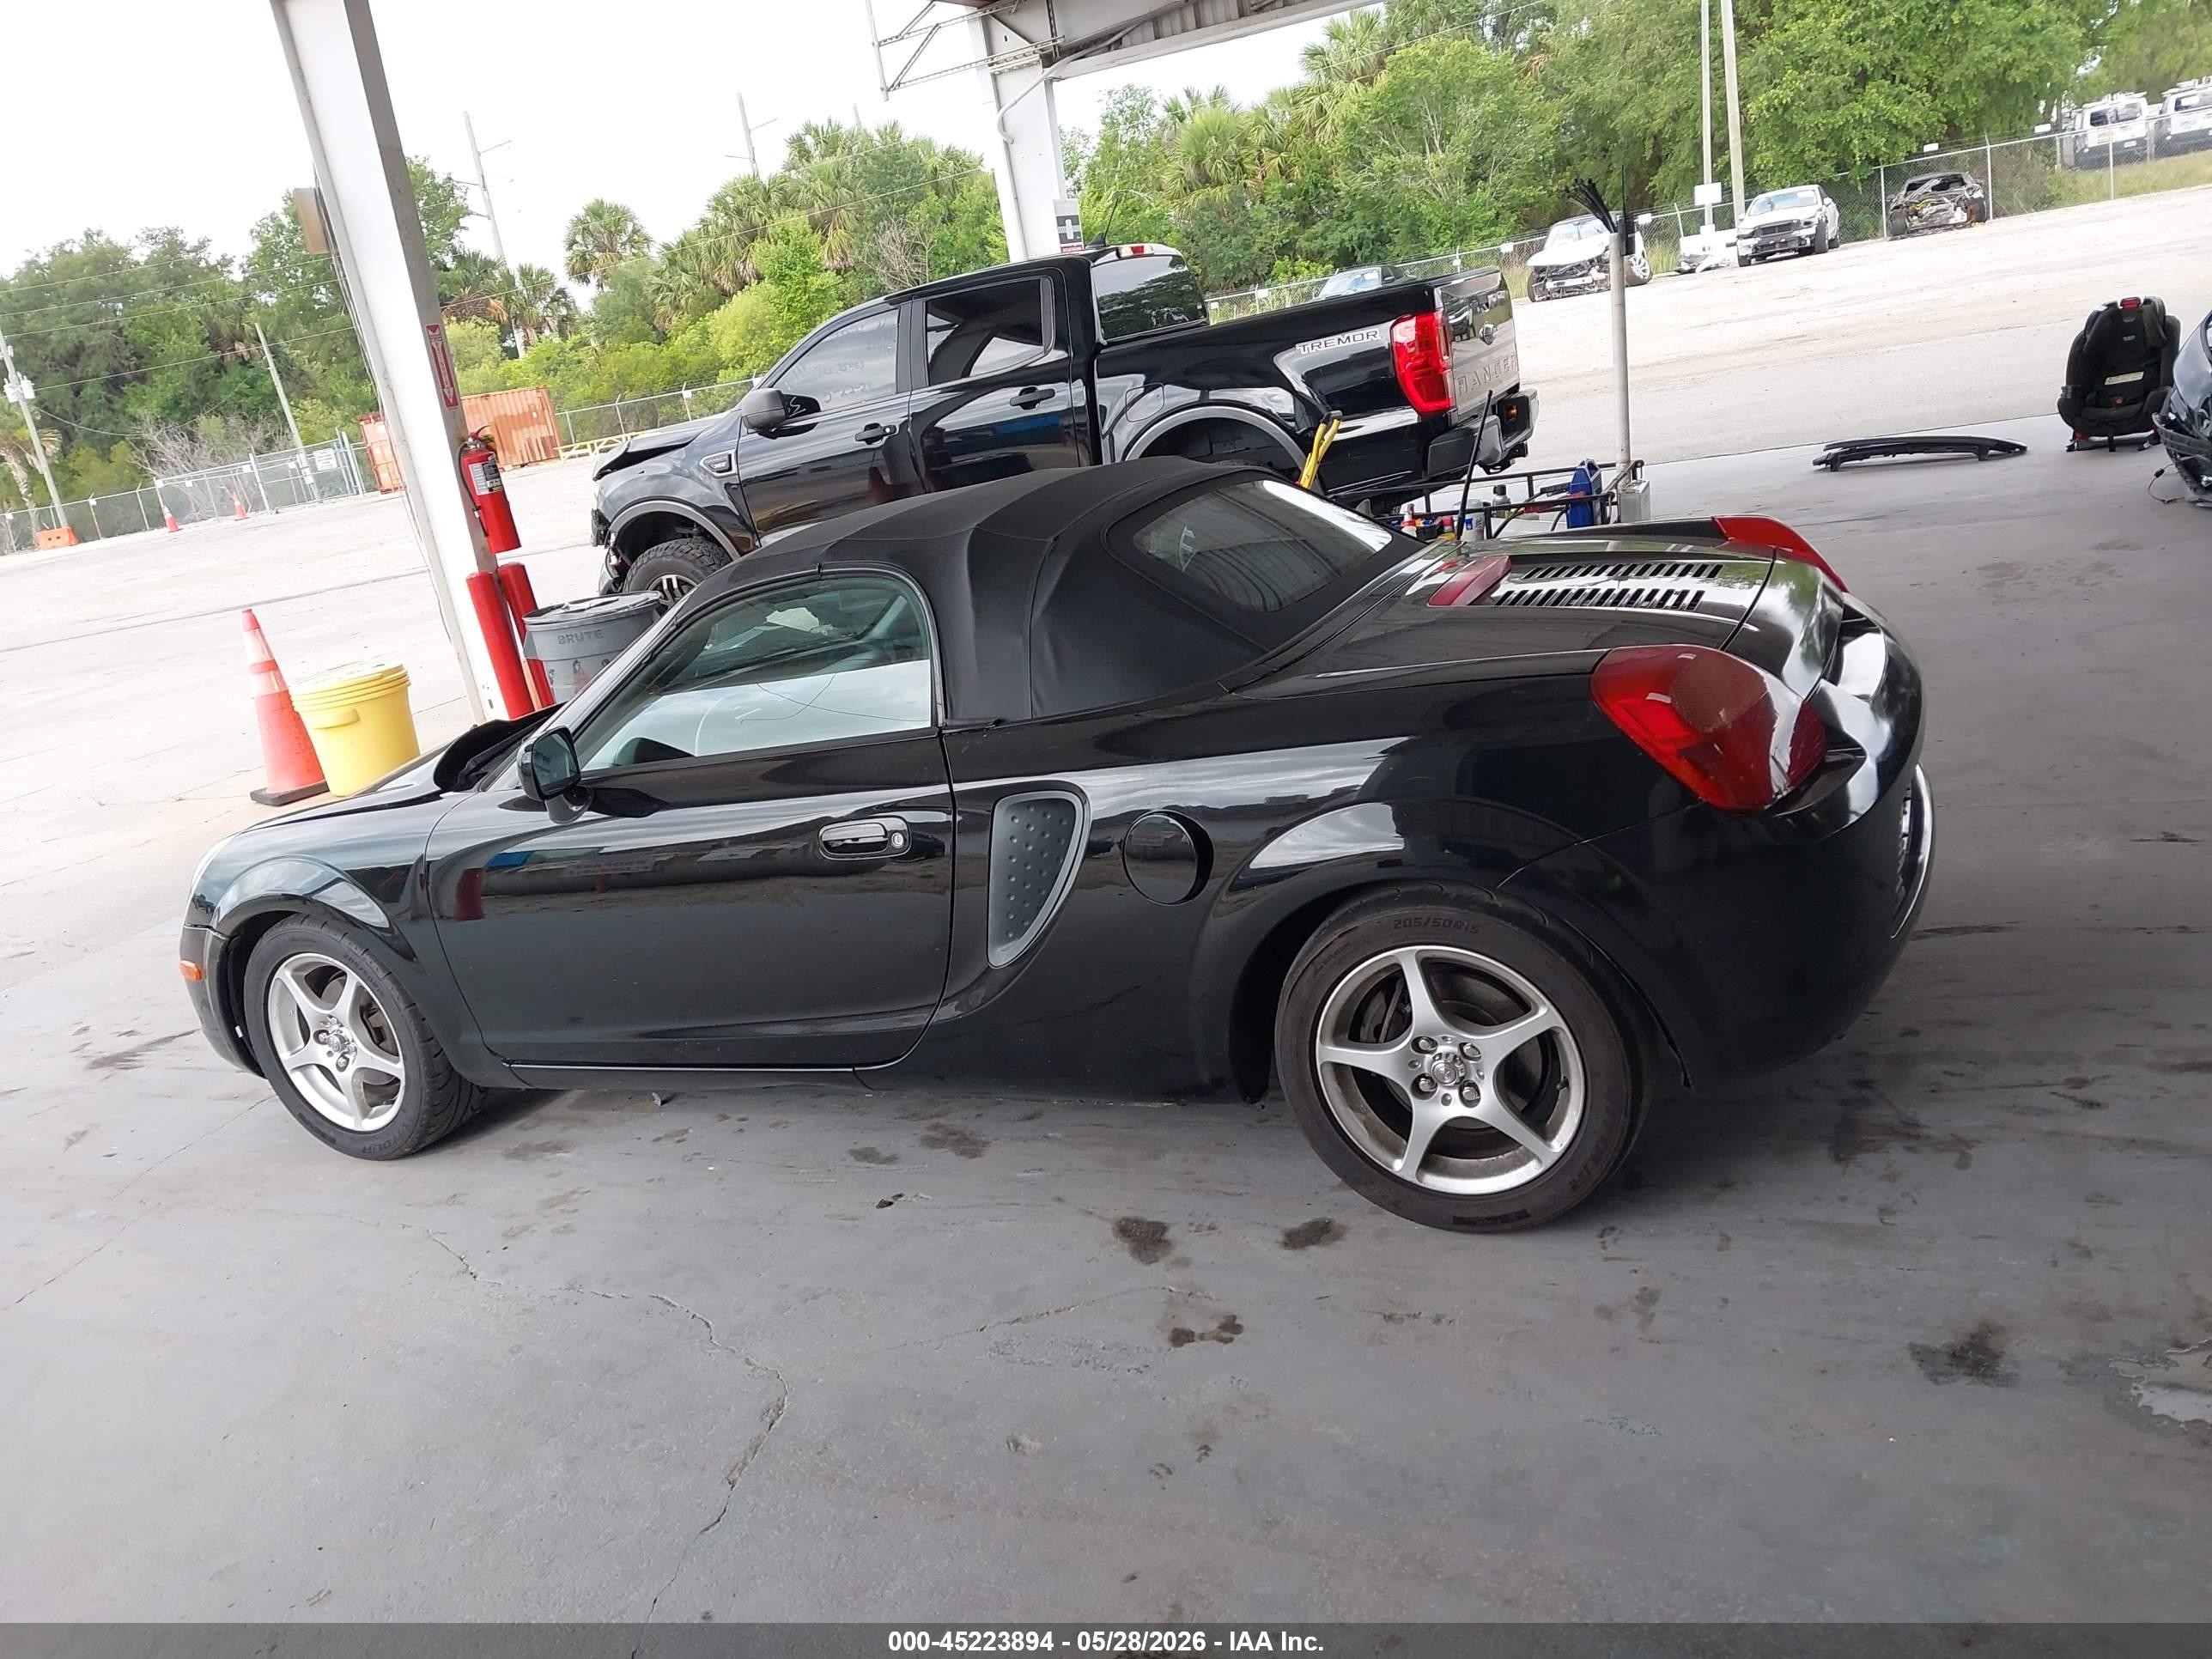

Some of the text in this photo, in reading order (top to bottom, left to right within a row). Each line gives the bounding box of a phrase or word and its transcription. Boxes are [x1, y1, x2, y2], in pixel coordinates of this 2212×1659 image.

[1295, 328, 1381, 355] TREMOR
[1456, 350, 1517, 394] RANGER
[558, 629, 605, 645] BRUTE
